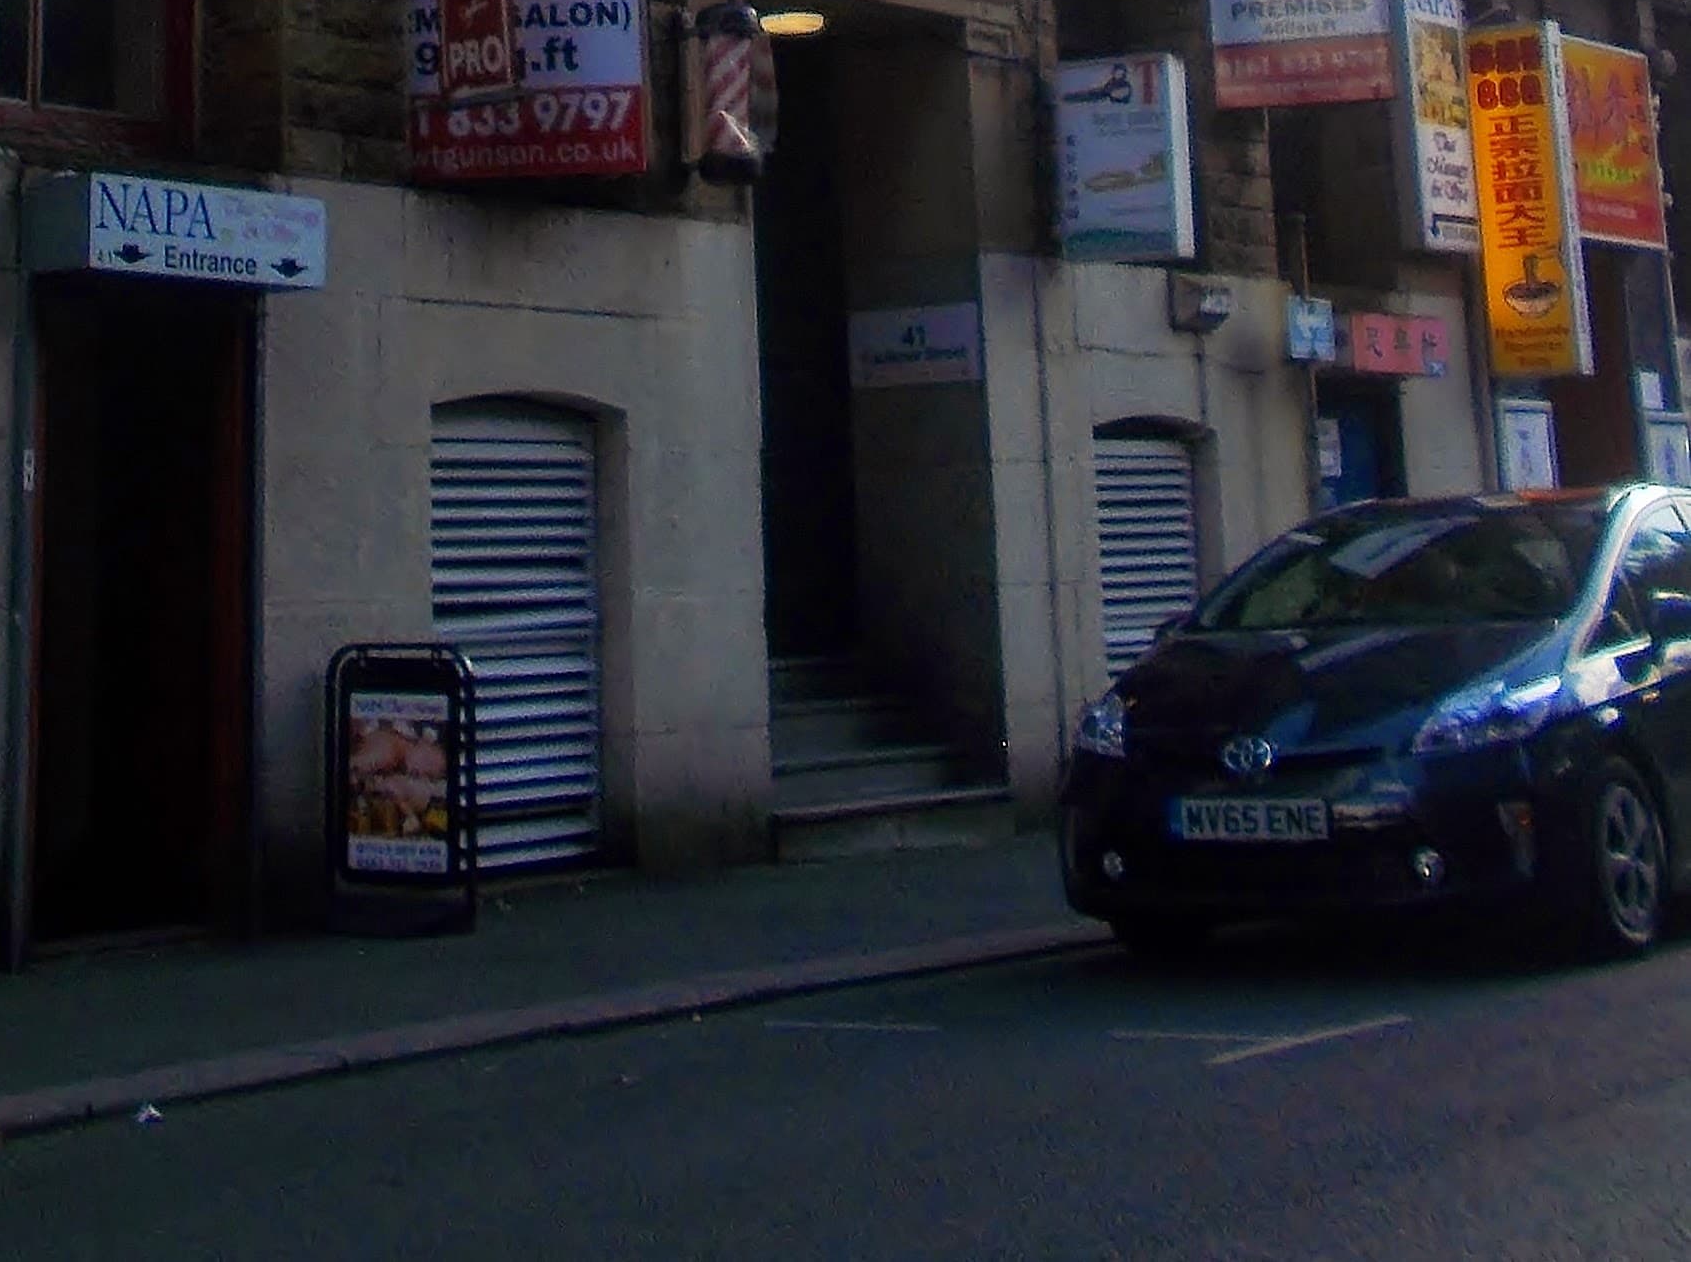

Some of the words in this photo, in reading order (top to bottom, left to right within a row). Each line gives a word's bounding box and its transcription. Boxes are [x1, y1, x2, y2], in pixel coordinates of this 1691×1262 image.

[449, 35, 503, 78] PRO
[533, 90, 632, 132] 9797
[95, 180, 215, 240] NAPA
[164, 245, 257, 275] Entrance
[1266, 804, 1323, 835] ENE
